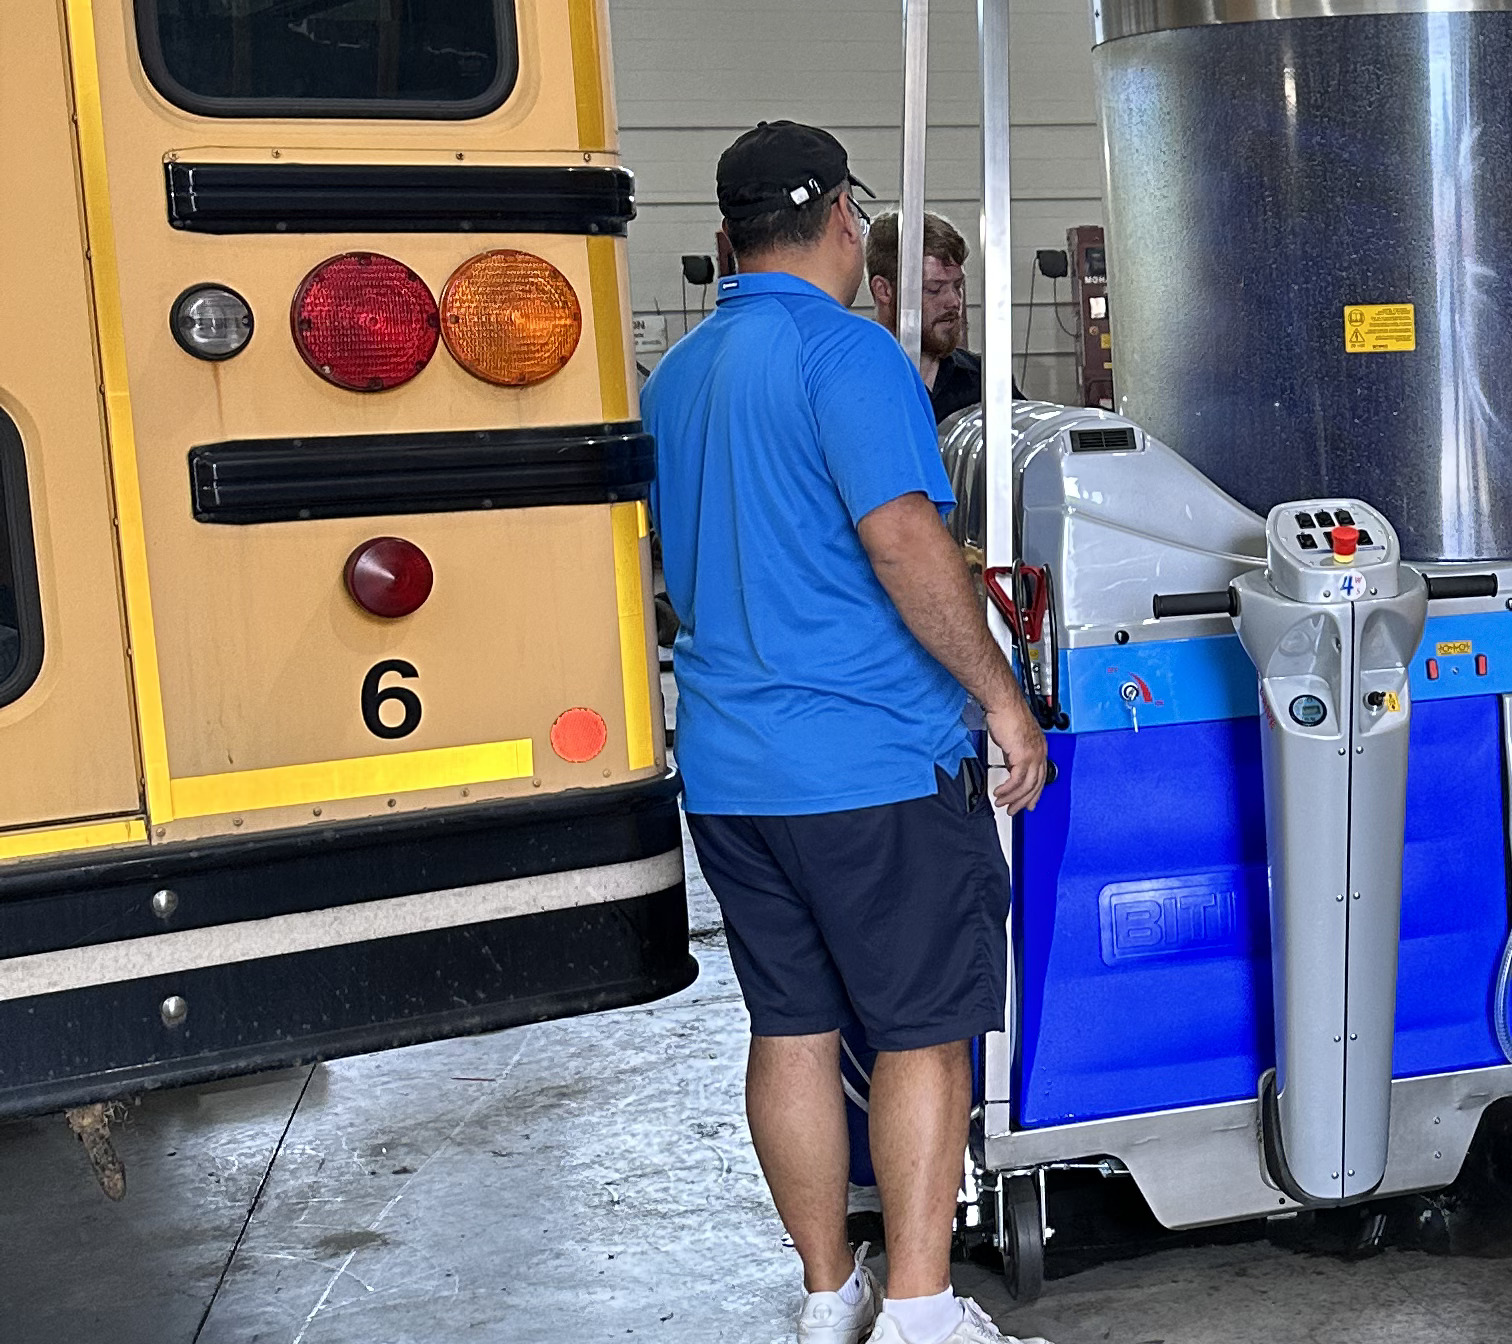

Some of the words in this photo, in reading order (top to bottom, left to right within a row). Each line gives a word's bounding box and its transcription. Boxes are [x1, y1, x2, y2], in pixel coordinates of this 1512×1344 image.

[1340, 575, 1354, 596] 4
[360, 659, 422, 739] 6
[1114, 891, 1237, 949] BITI
